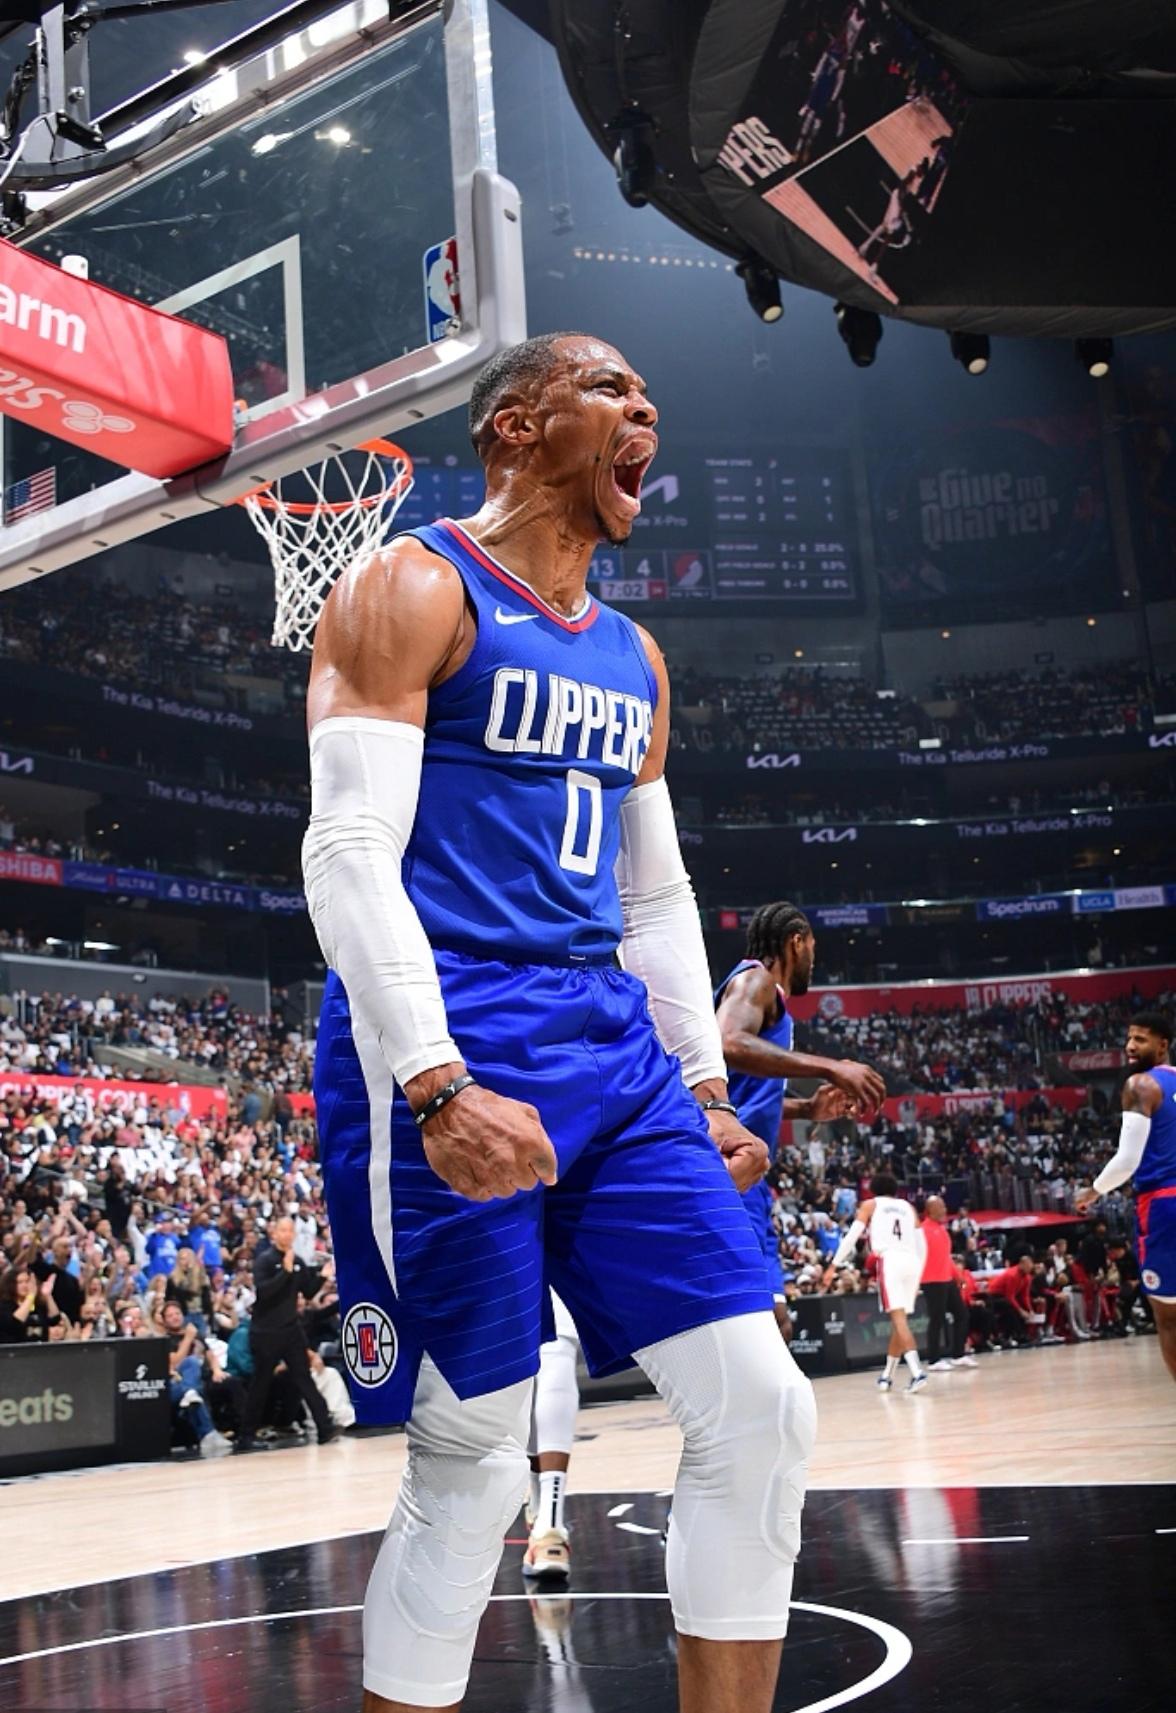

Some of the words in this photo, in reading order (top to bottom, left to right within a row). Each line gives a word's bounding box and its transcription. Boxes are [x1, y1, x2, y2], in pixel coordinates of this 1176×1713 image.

[717, 116, 794, 186] PERS
[636, 558, 652, 577] 4
[605, 582, 644, 598] 7:02
[102, 685, 128, 704] The
[131, 693, 154, 710] Kia
[213, 712, 253, 730] X-Pro
[485, 667, 654, 776] CLIPPERS
[898, 752, 923, 765] The
[925, 752, 947, 764] Kia
[950, 748, 1006, 763] Telluride
[1009, 744, 1048, 758] X-Pro
[258, 801, 301, 819] X-Pro
[559, 768, 603, 876] 0
[957, 824, 982, 837] The
[985, 823, 1008, 836] Kia
[1012, 819, 1070, 834] Telluride
[1072, 815, 1112, 829] X-Pro
[679, 830, 704, 844] Pro
[187, 885, 244, 905] DELTA
[1081, 898, 1111, 908] UCLA
[986, 898, 1059, 918] Spectrum
[892, 1218, 902, 1241] 4
[0, 1388, 74, 1427] eats
